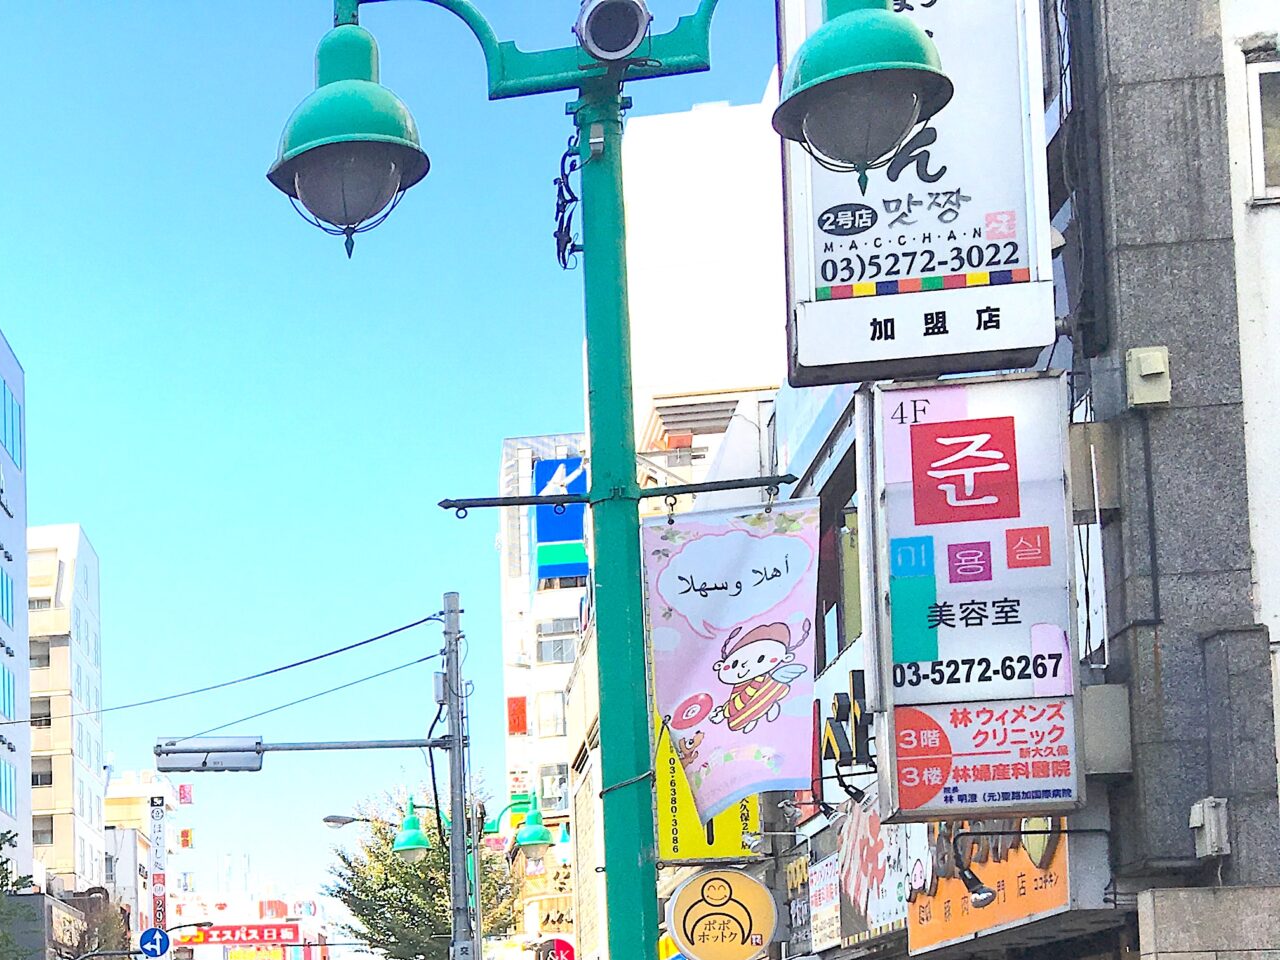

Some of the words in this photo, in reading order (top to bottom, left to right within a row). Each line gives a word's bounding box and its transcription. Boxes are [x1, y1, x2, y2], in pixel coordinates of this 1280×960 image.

[822, 208, 873, 231] 2号店
[820, 241, 1020, 283] 03)5272-3022
[870, 305, 1001, 341] 加盟店
[890, 399, 931, 425] 4F
[926, 433, 1011, 507] 준
[927, 597, 1023, 630] 美容室
[892, 653, 1063, 688] 03-5272-6267
[949, 700, 1067, 729] 林ウィメンズ
[898, 729, 941, 750] 3階
[972, 724, 1066, 749] クリニック
[698, 931, 739, 944] ホットク
